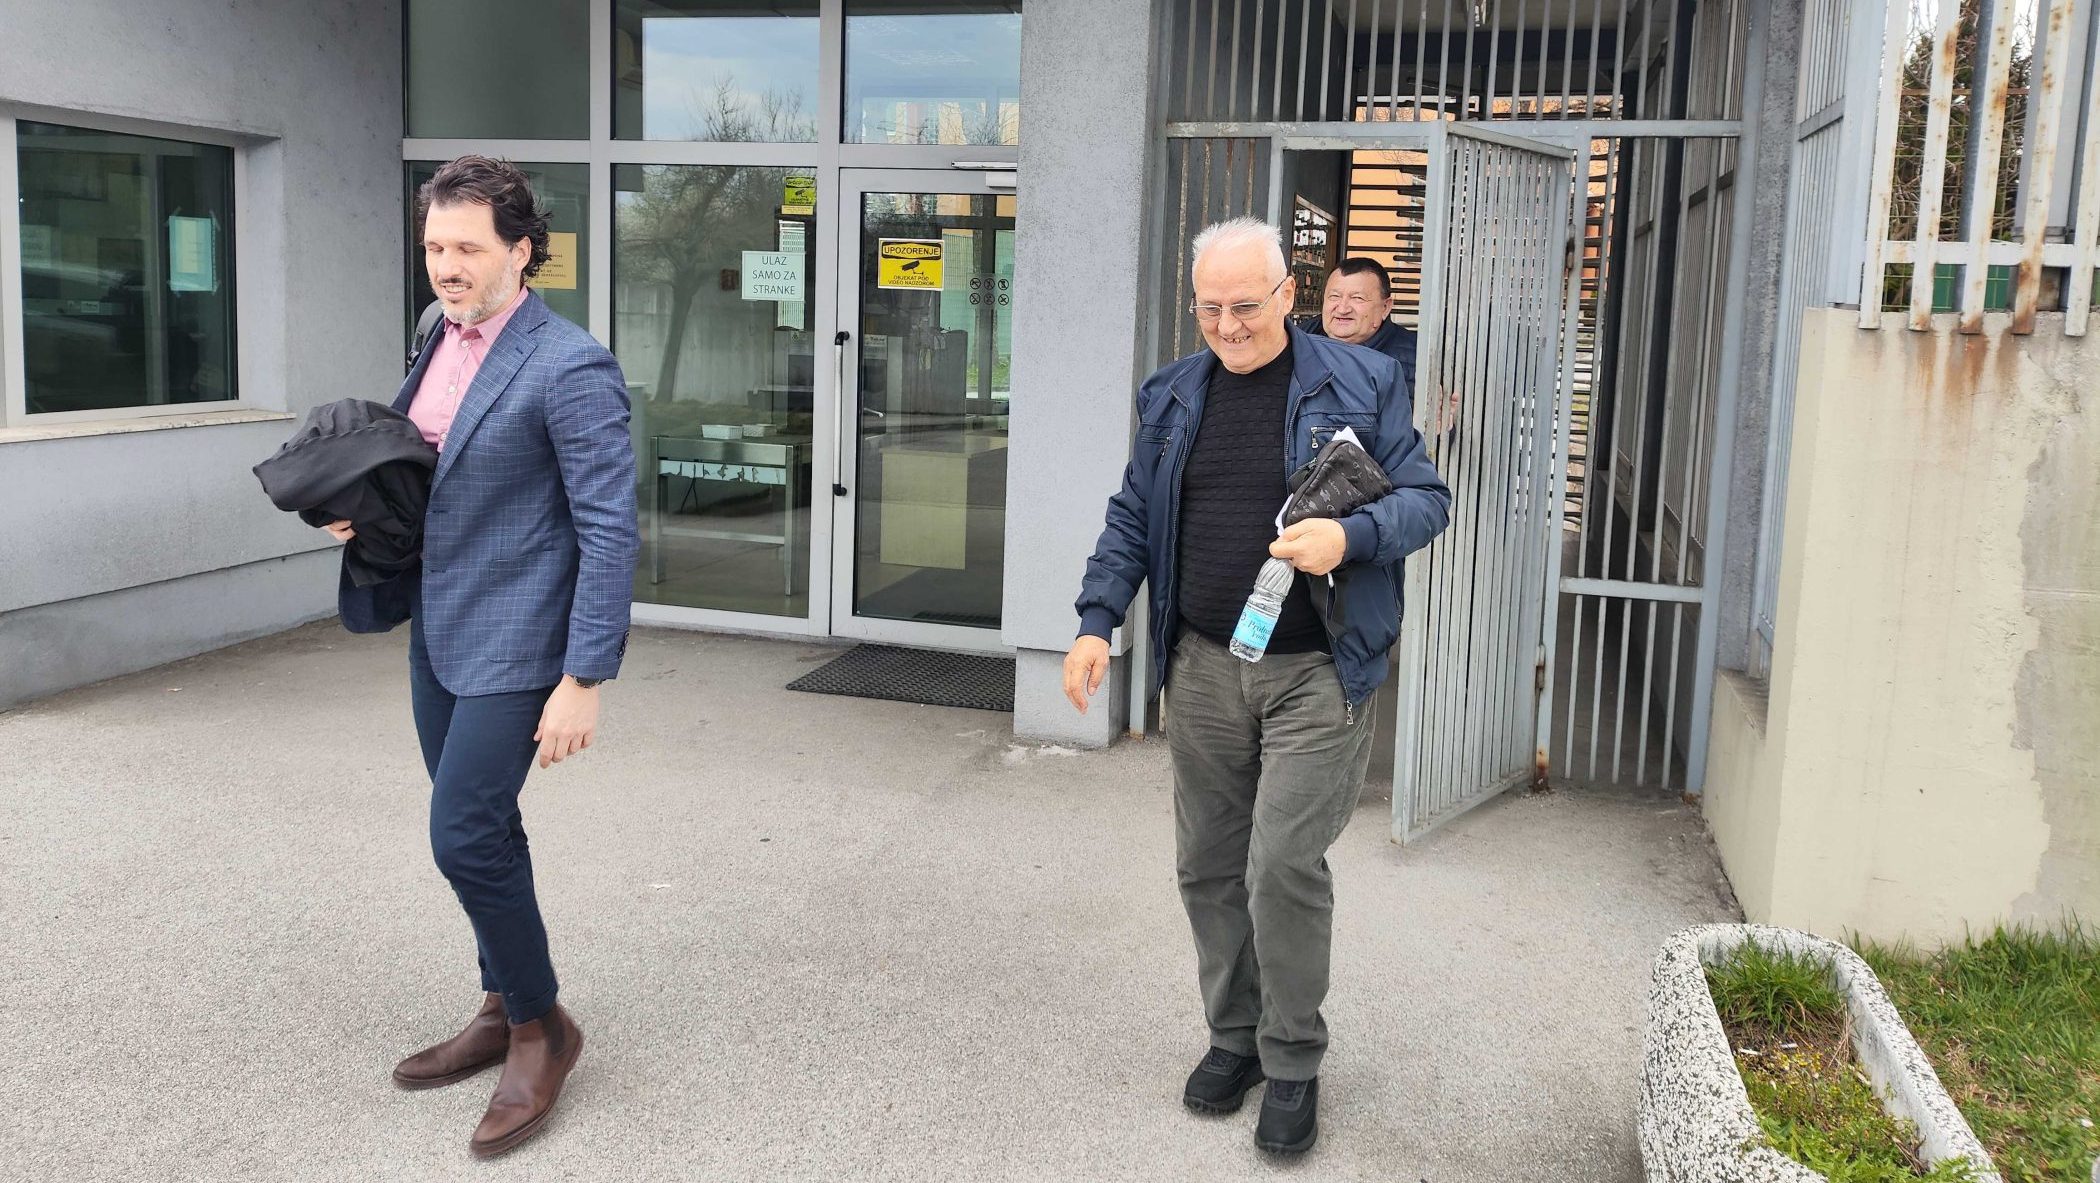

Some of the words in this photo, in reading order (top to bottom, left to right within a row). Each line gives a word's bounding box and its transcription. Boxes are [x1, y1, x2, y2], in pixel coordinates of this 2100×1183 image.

[884, 247, 939, 255] UPOZORENJE
[762, 255, 787, 266] ULAZ
[752, 269, 781, 280] SAMO
[783, 270, 796, 280] ZA
[753, 284, 796, 295] STRANKE
